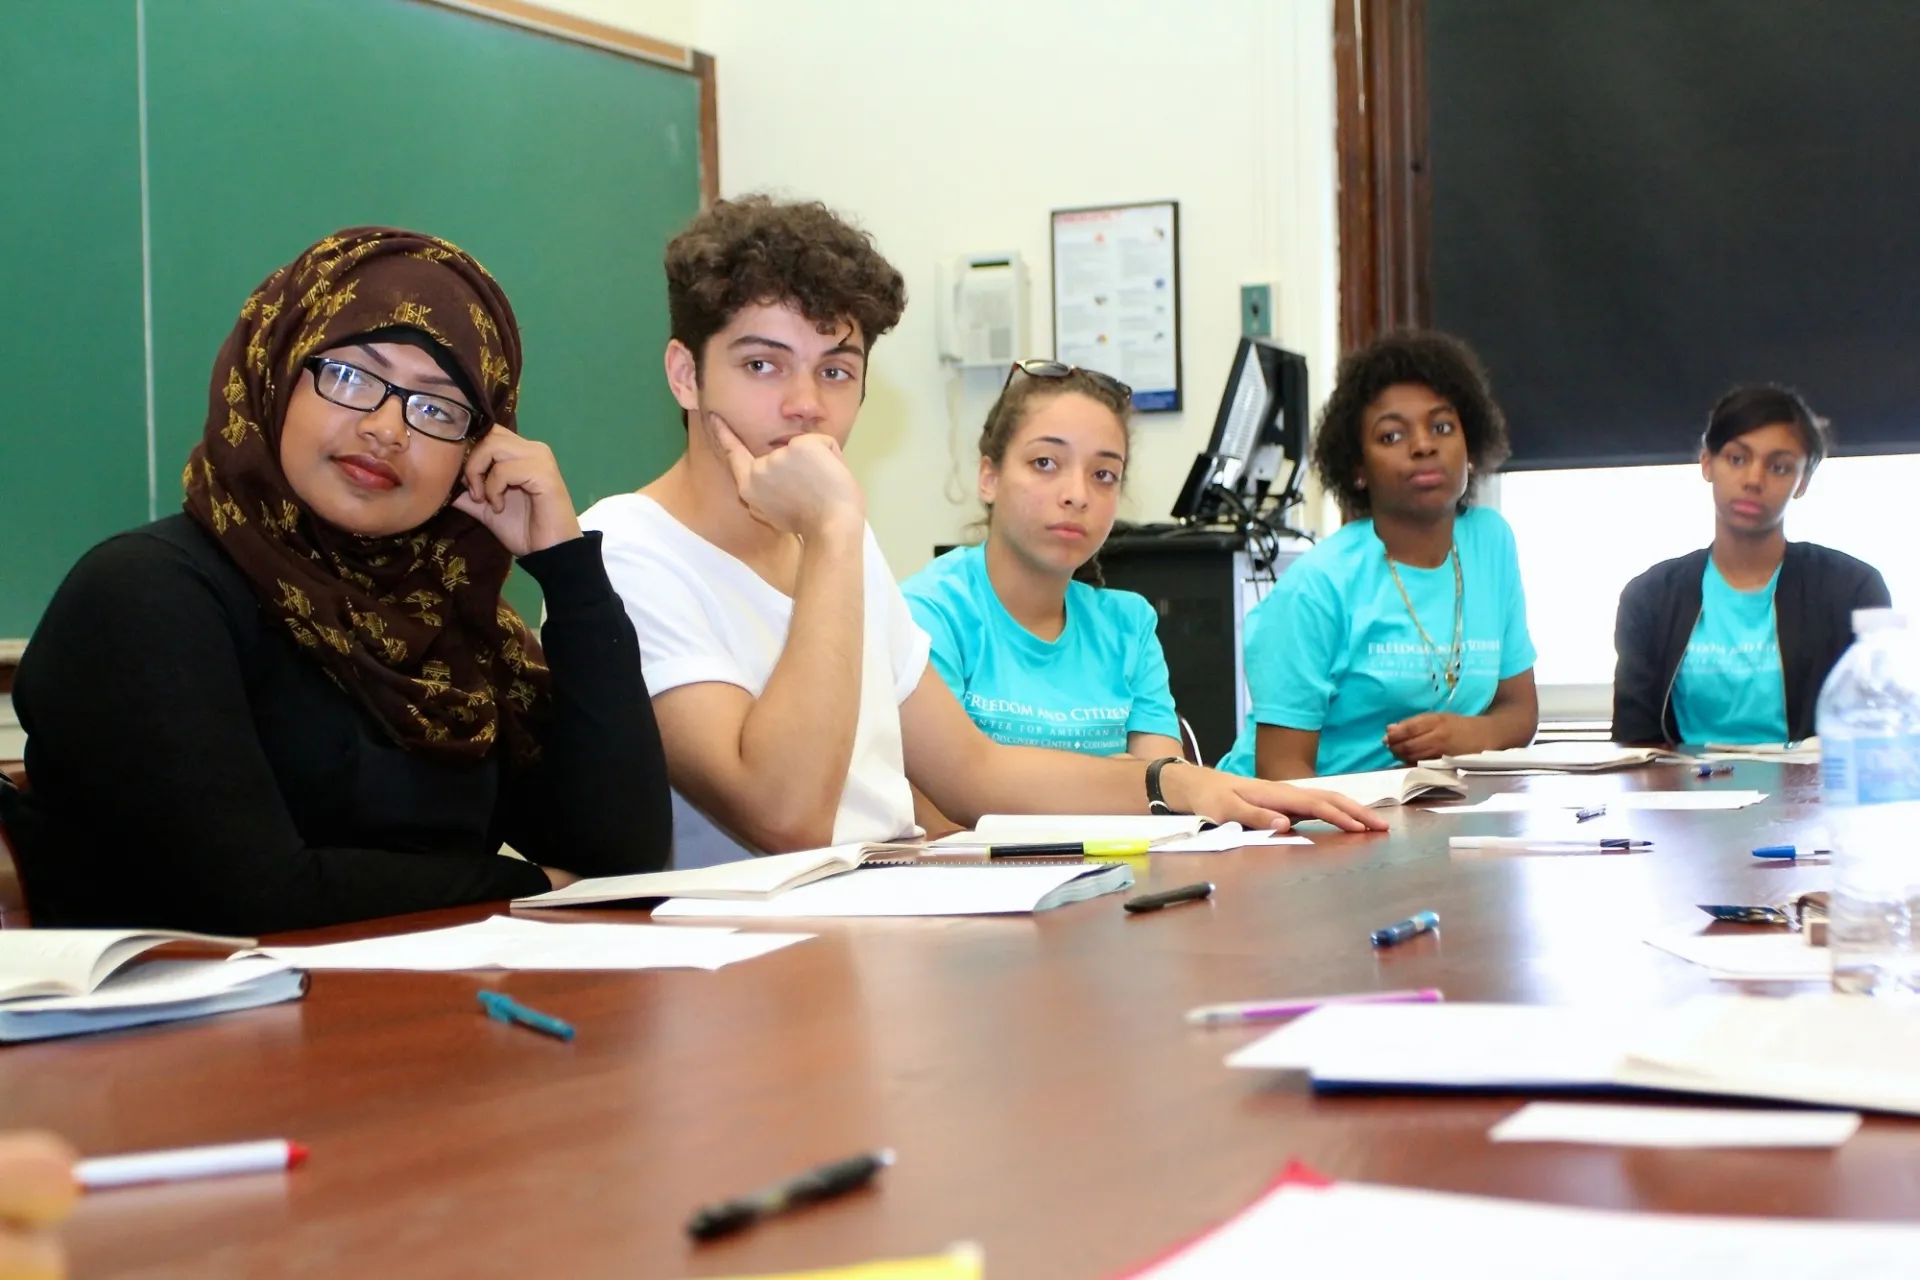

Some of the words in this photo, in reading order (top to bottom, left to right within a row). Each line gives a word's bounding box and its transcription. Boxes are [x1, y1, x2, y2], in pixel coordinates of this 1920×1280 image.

[964, 691, 1033, 716] FREEDOM
[1038, 708, 1067, 721] AND
[1020, 724, 1043, 735] FOR
[1049, 728, 1109, 737] AMERICAN
